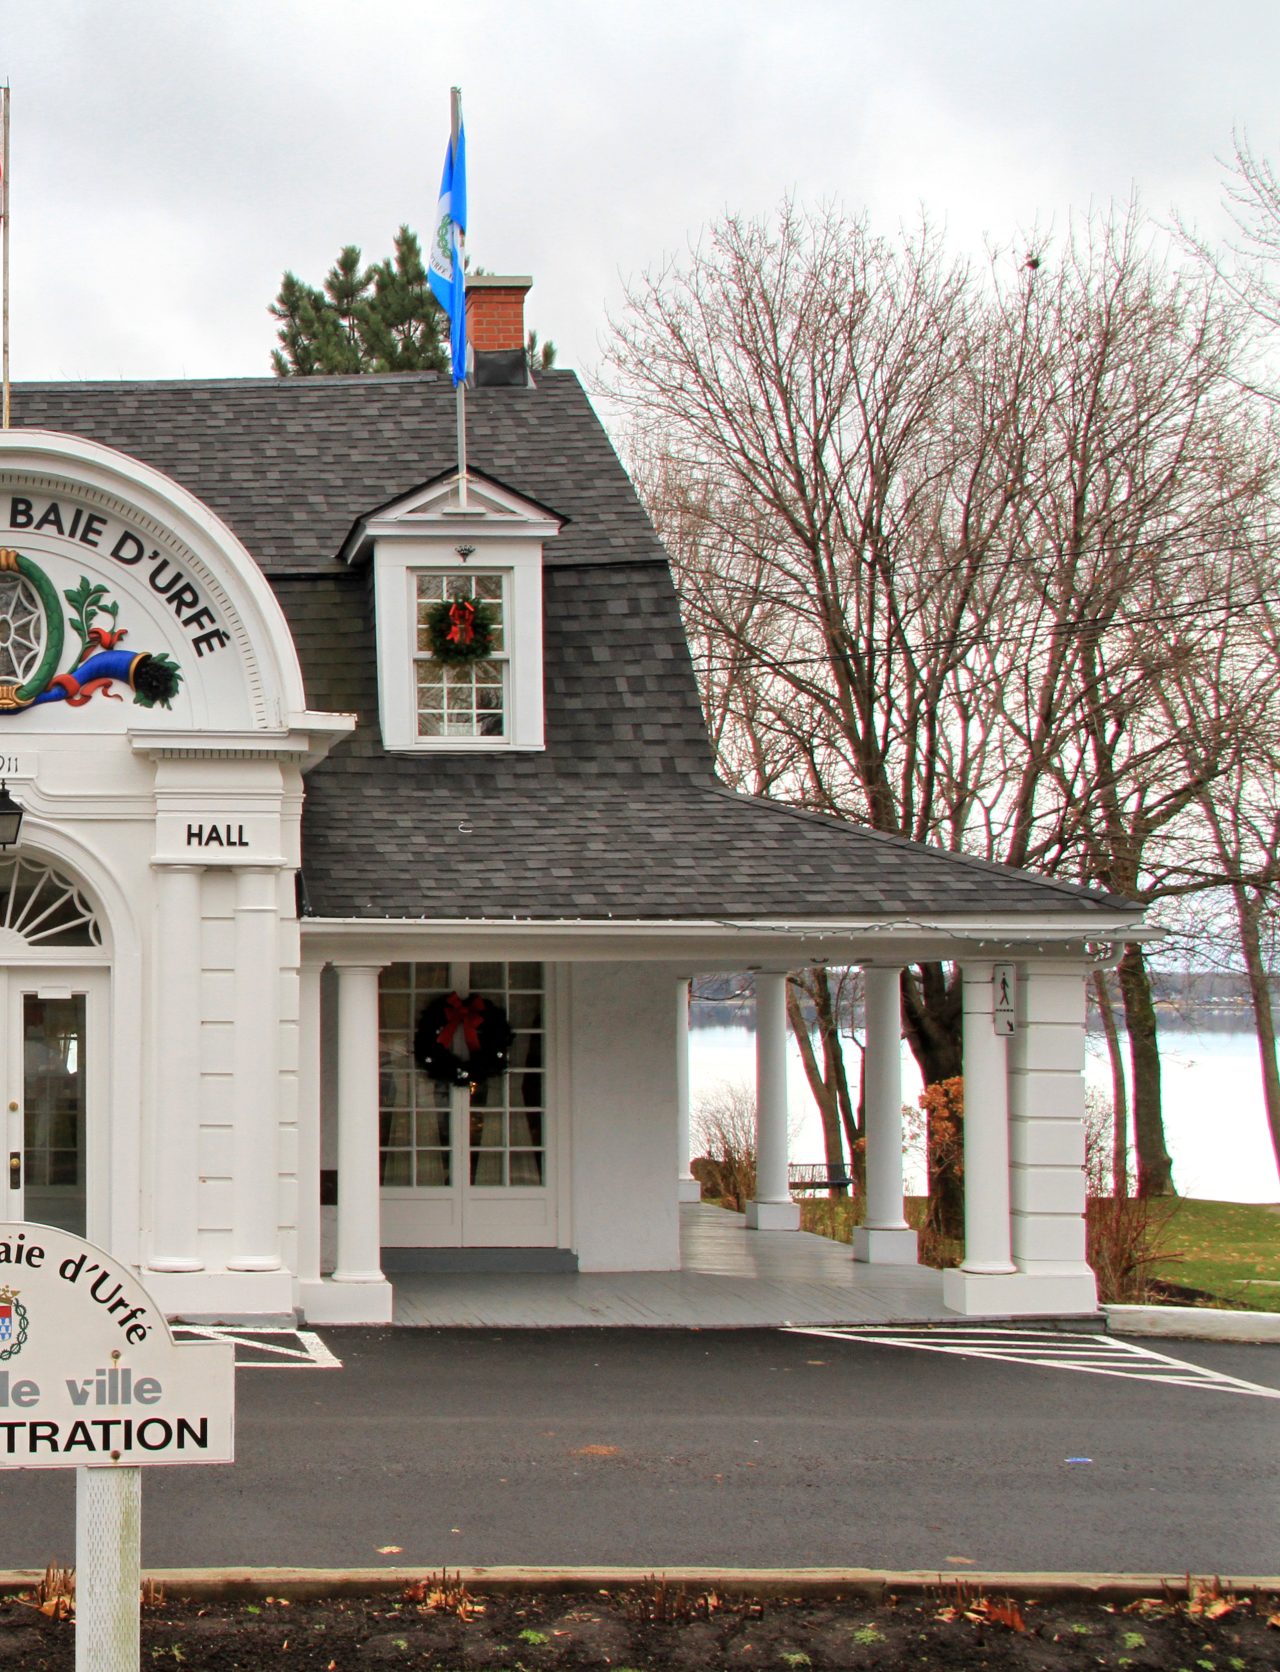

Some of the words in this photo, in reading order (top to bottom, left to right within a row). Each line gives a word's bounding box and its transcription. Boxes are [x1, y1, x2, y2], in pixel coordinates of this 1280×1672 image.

[9, 497, 108, 548] BAIE
[110, 530, 231, 658] D'URFÉ
[186, 823, 249, 847] HALL
[59, 1253, 152, 1346] d'Urfé
[65, 1368, 163, 1406] ville
